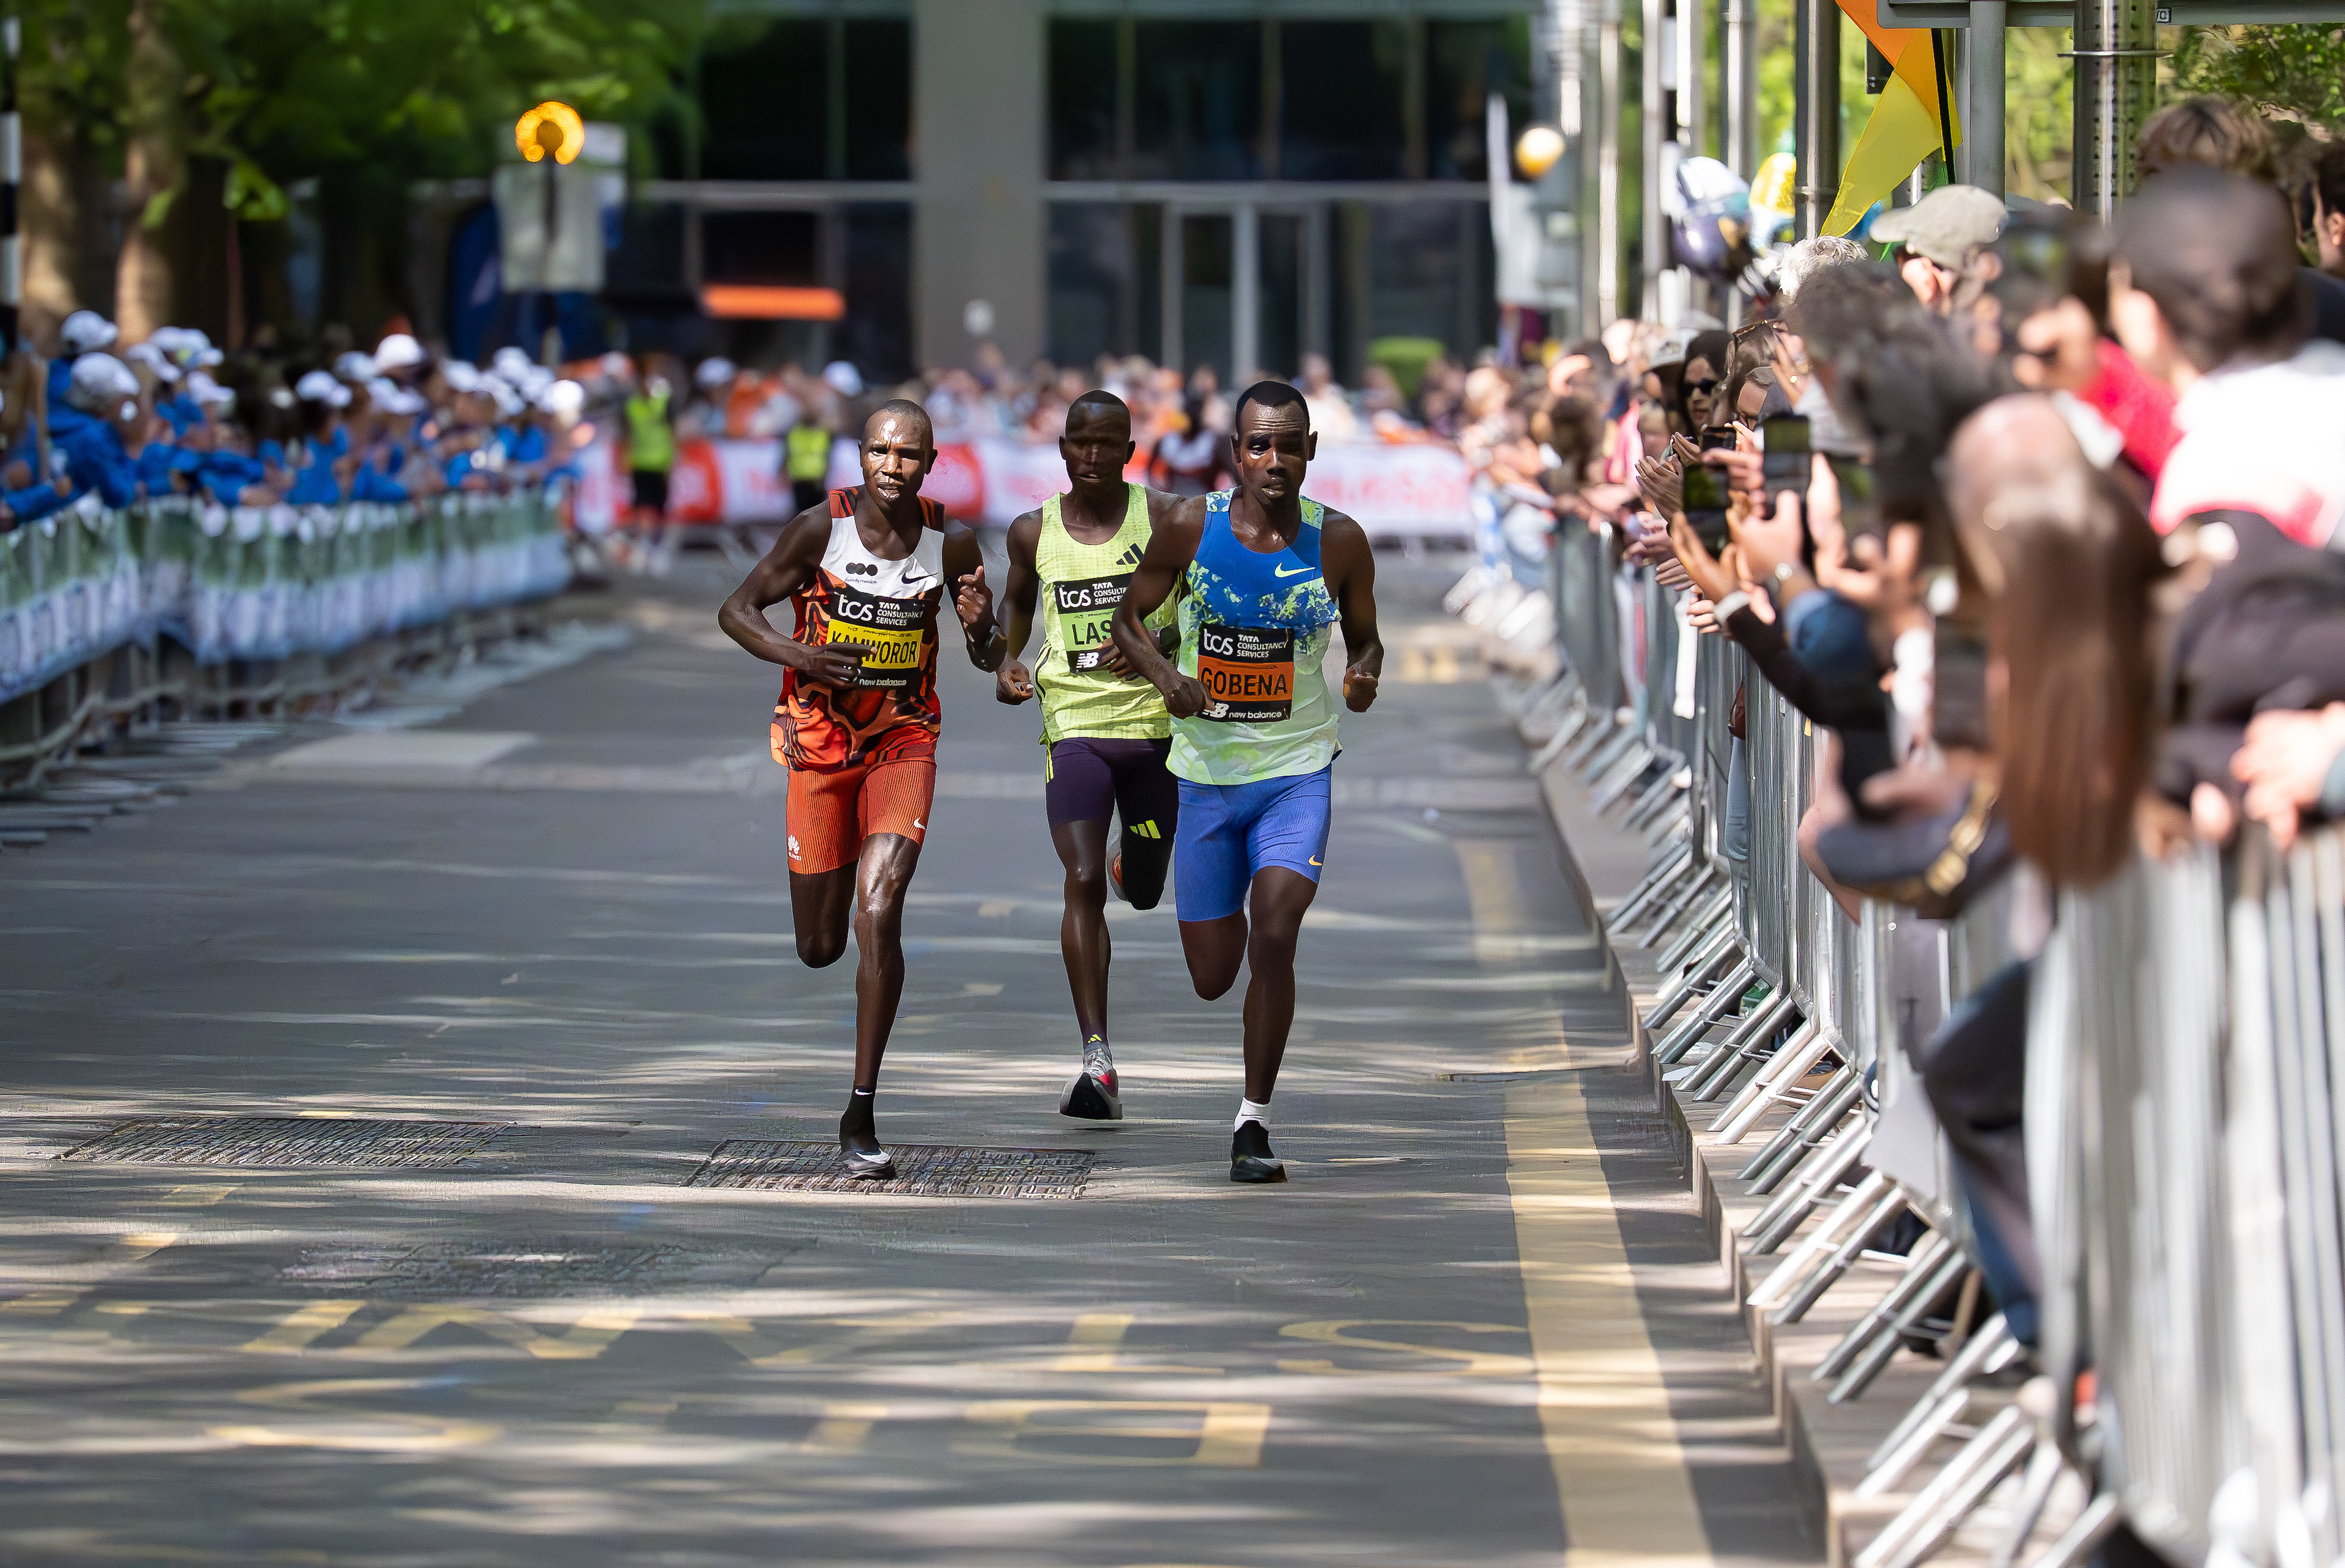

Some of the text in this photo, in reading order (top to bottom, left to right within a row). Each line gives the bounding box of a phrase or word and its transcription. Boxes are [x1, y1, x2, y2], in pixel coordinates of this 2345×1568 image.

[1092, 582, 1113, 590] TATA
[1059, 587, 1092, 608] tcs
[1094, 587, 1129, 598] CONSULTA
[879, 601, 900, 611] TATA
[1094, 595, 1123, 606] SERVICE
[838, 594, 874, 622] tcs
[875, 617, 907, 626] SERVICES
[1204, 628, 1234, 655] tcs
[1238, 634, 1259, 643] TATA
[832, 630, 917, 664] KWOROR
[1237, 649, 1269, 658] SERVICES
[1201, 667, 1287, 696] GOBENA
